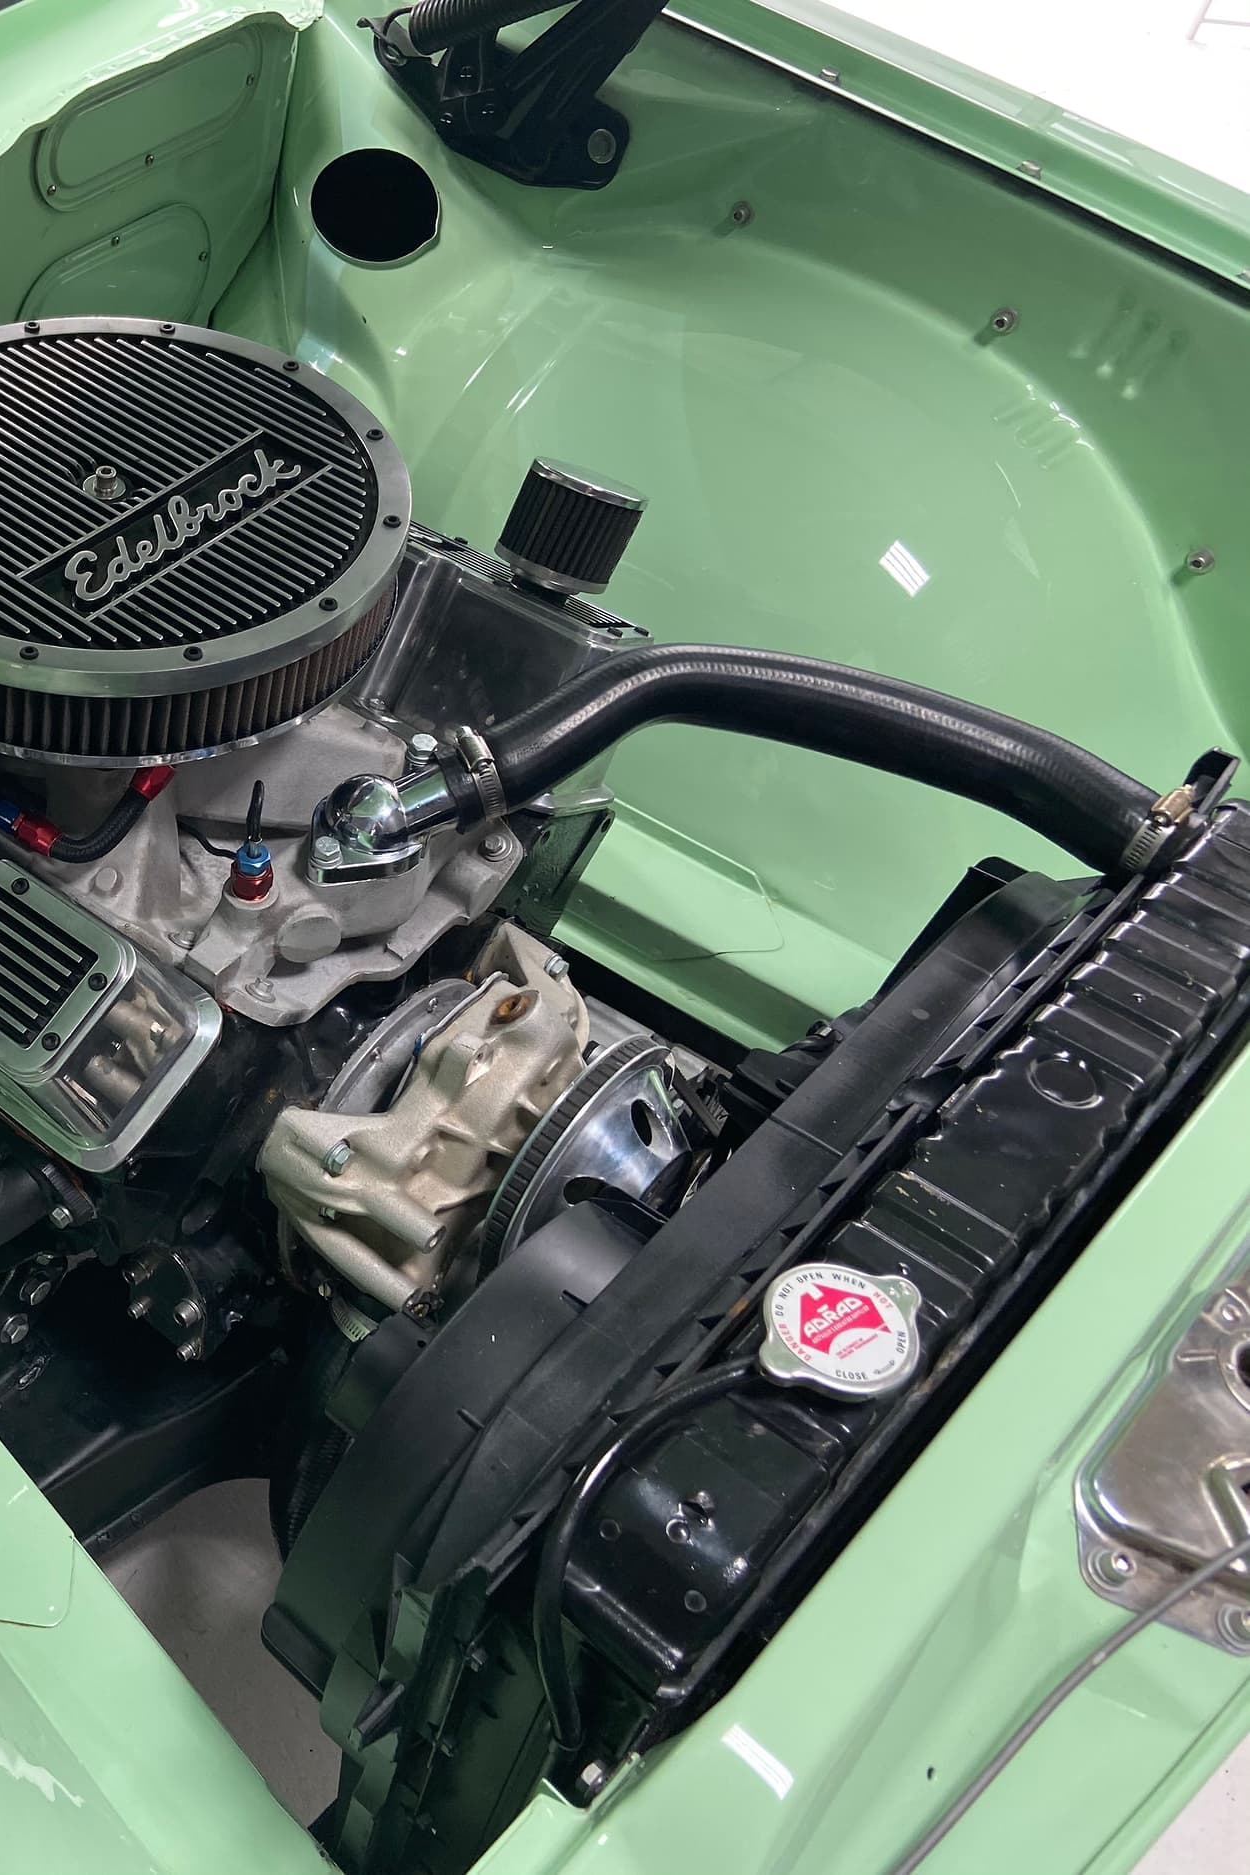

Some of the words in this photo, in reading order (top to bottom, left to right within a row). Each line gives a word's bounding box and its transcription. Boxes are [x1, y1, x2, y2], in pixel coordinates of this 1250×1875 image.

[65, 449, 302, 602] Edelbrock
[796, 1271, 823, 1283] OPEN
[832, 1273, 866, 1289] WHEN
[780, 1283, 794, 1299] NOT
[873, 1292, 893, 1310] HOT
[775, 1304, 784, 1316] DO
[803, 1297, 864, 1338] ADRAD
[778, 1323, 812, 1361] DANGER
[896, 1331, 907, 1354] OPEN
[835, 1370, 868, 1380] CLOSE
